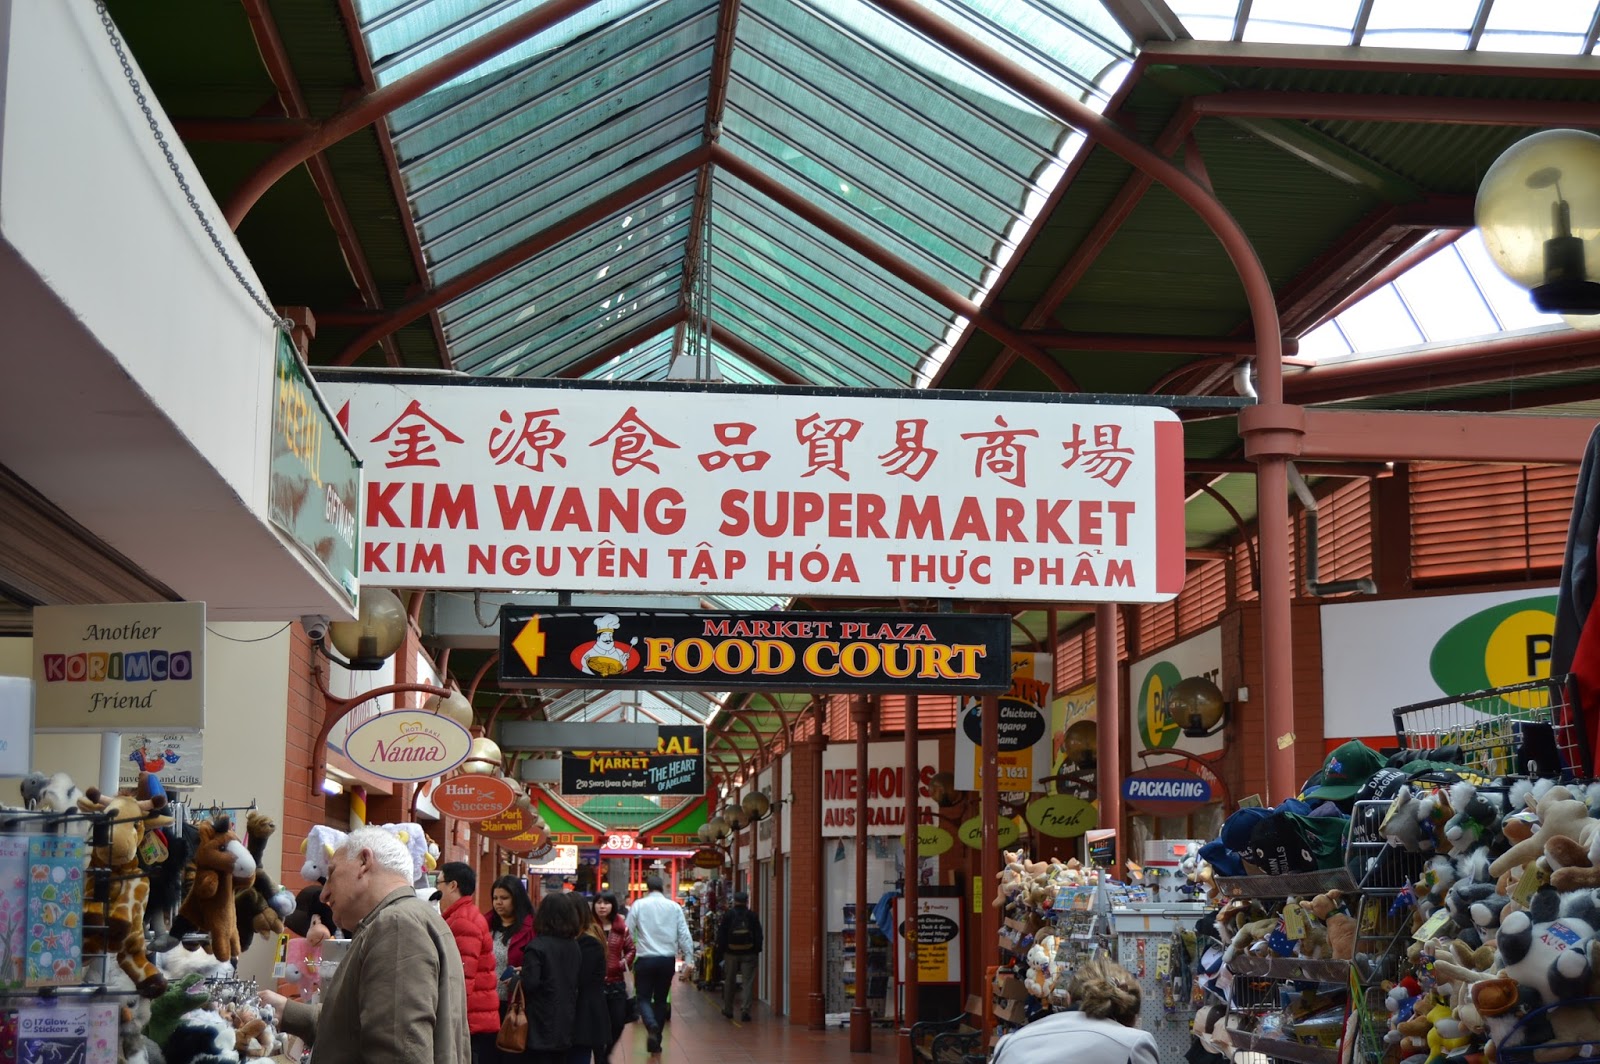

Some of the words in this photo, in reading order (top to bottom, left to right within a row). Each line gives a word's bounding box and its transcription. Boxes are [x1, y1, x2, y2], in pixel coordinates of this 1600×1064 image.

[370, 399, 1135, 489] 金源食品貿易商場
[325, 484, 354, 549] GIFTWARE
[365, 481, 479, 530] KIM
[493, 484, 687, 536] WANG
[718, 488, 1136, 547] SUPERMARKET
[363, 541, 446, 574] KIM
[468, 539, 648, 579] NGUYÊN
[667, 541, 747, 586] TẬP
[767, 543, 861, 584] HÓA
[886, 549, 991, 590] THỰC
[1013, 549, 1136, 588] PHẨM
[82, 621, 162, 642] Another
[702, 619, 833, 639] MARKET
[840, 622, 937, 642] PLAZA
[43, 650, 193, 682] KORIMCO
[643, 637, 796, 675] FOOD
[802, 641, 987, 680] COURT
[87, 689, 158, 714] Friend
[1000, 707, 1037, 719] Chickens
[997, 723, 1027, 733] ngaroo
[370, 738, 446, 764] Nanna
[589, 757, 650, 774] MARKET
[669, 759, 697, 775] HEART
[1006, 767, 1028, 778] 1621
[178, 775, 200, 784] Gifts
[824, 765, 937, 801] MEMOIS
[1368, 769, 1390, 789] DAMN
[445, 784, 476, 796] Hair
[1128, 780, 1205, 798] PACKAGING
[452, 800, 503, 812] Success
[501, 807, 522, 820] Park
[480, 820, 523, 832] Stairwell
[824, 805, 935, 828] AUSRALIAA
[1039, 806, 1085, 827] Fresh
[968, 826, 1010, 840] Chen
[33, 1025, 69, 1033] Stickers
[34, 1018, 44, 1026] 17
[45, 1018, 68, 1026] Glow
